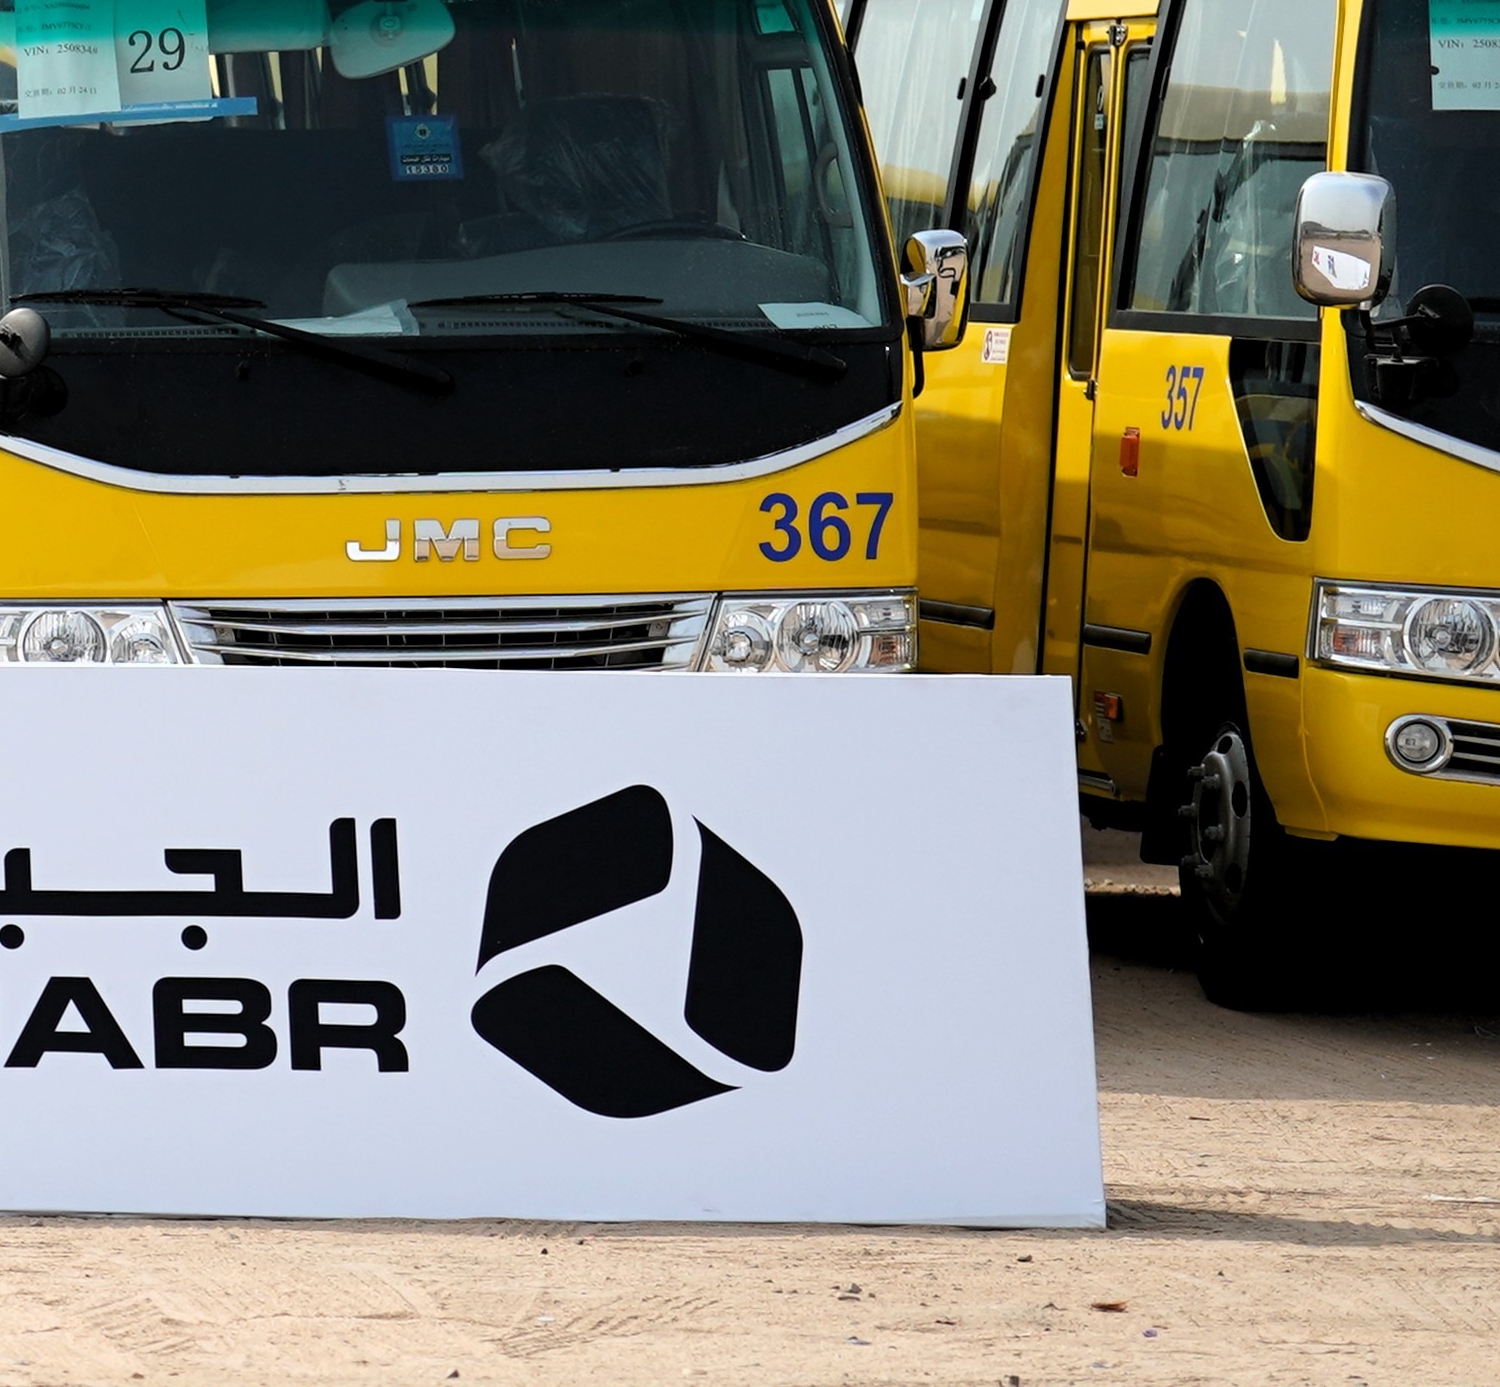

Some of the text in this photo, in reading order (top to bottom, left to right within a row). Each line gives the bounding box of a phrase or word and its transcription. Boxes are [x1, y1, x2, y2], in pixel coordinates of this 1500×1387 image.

[128, 27, 186, 74] 29
[1161, 365, 1204, 430] 357
[345, 516, 552, 562] JMC
[759, 492, 894, 562] 367
